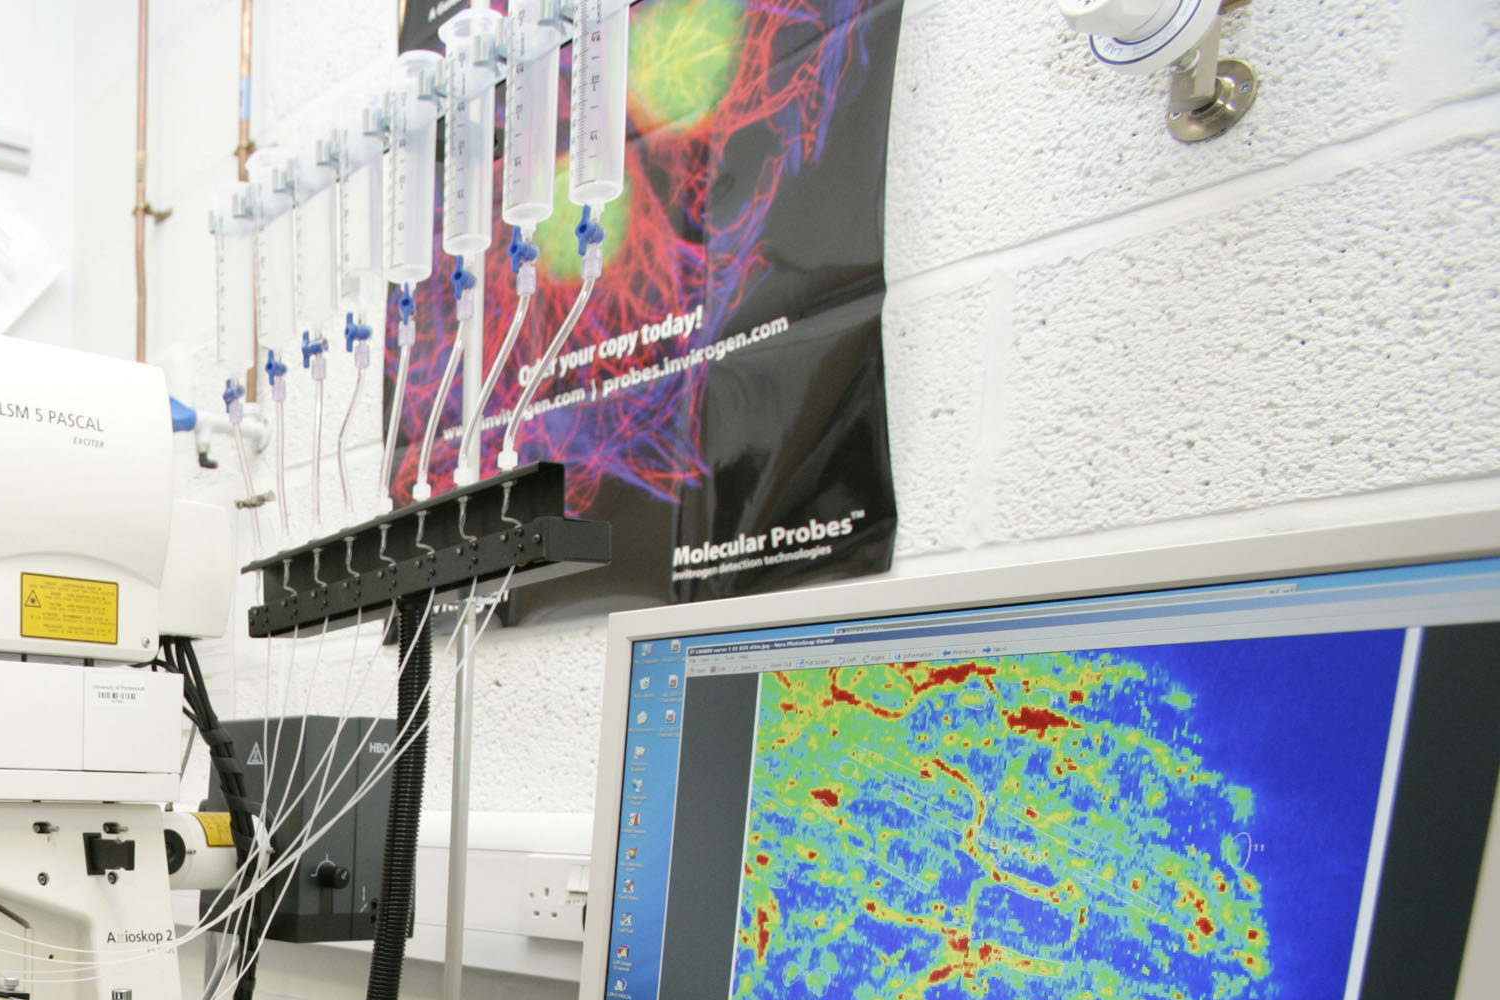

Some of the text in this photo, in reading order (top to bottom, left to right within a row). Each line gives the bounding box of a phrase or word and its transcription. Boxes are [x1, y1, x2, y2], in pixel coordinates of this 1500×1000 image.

[558, 342, 598, 378] your
[598, 329, 639, 360] copy
[641, 304, 703, 345] today!
[601, 315, 789, 397] probes.invirogen.com
[35, 408, 43, 422] 5
[48, 410, 104, 432] PASCAL
[73, 436, 105, 448] EXCITER
[672, 533, 768, 567] Molecular
[719, 557, 763, 574] detection
[764, 544, 833, 567] technologies
[166, 929, 173, 941] 2
